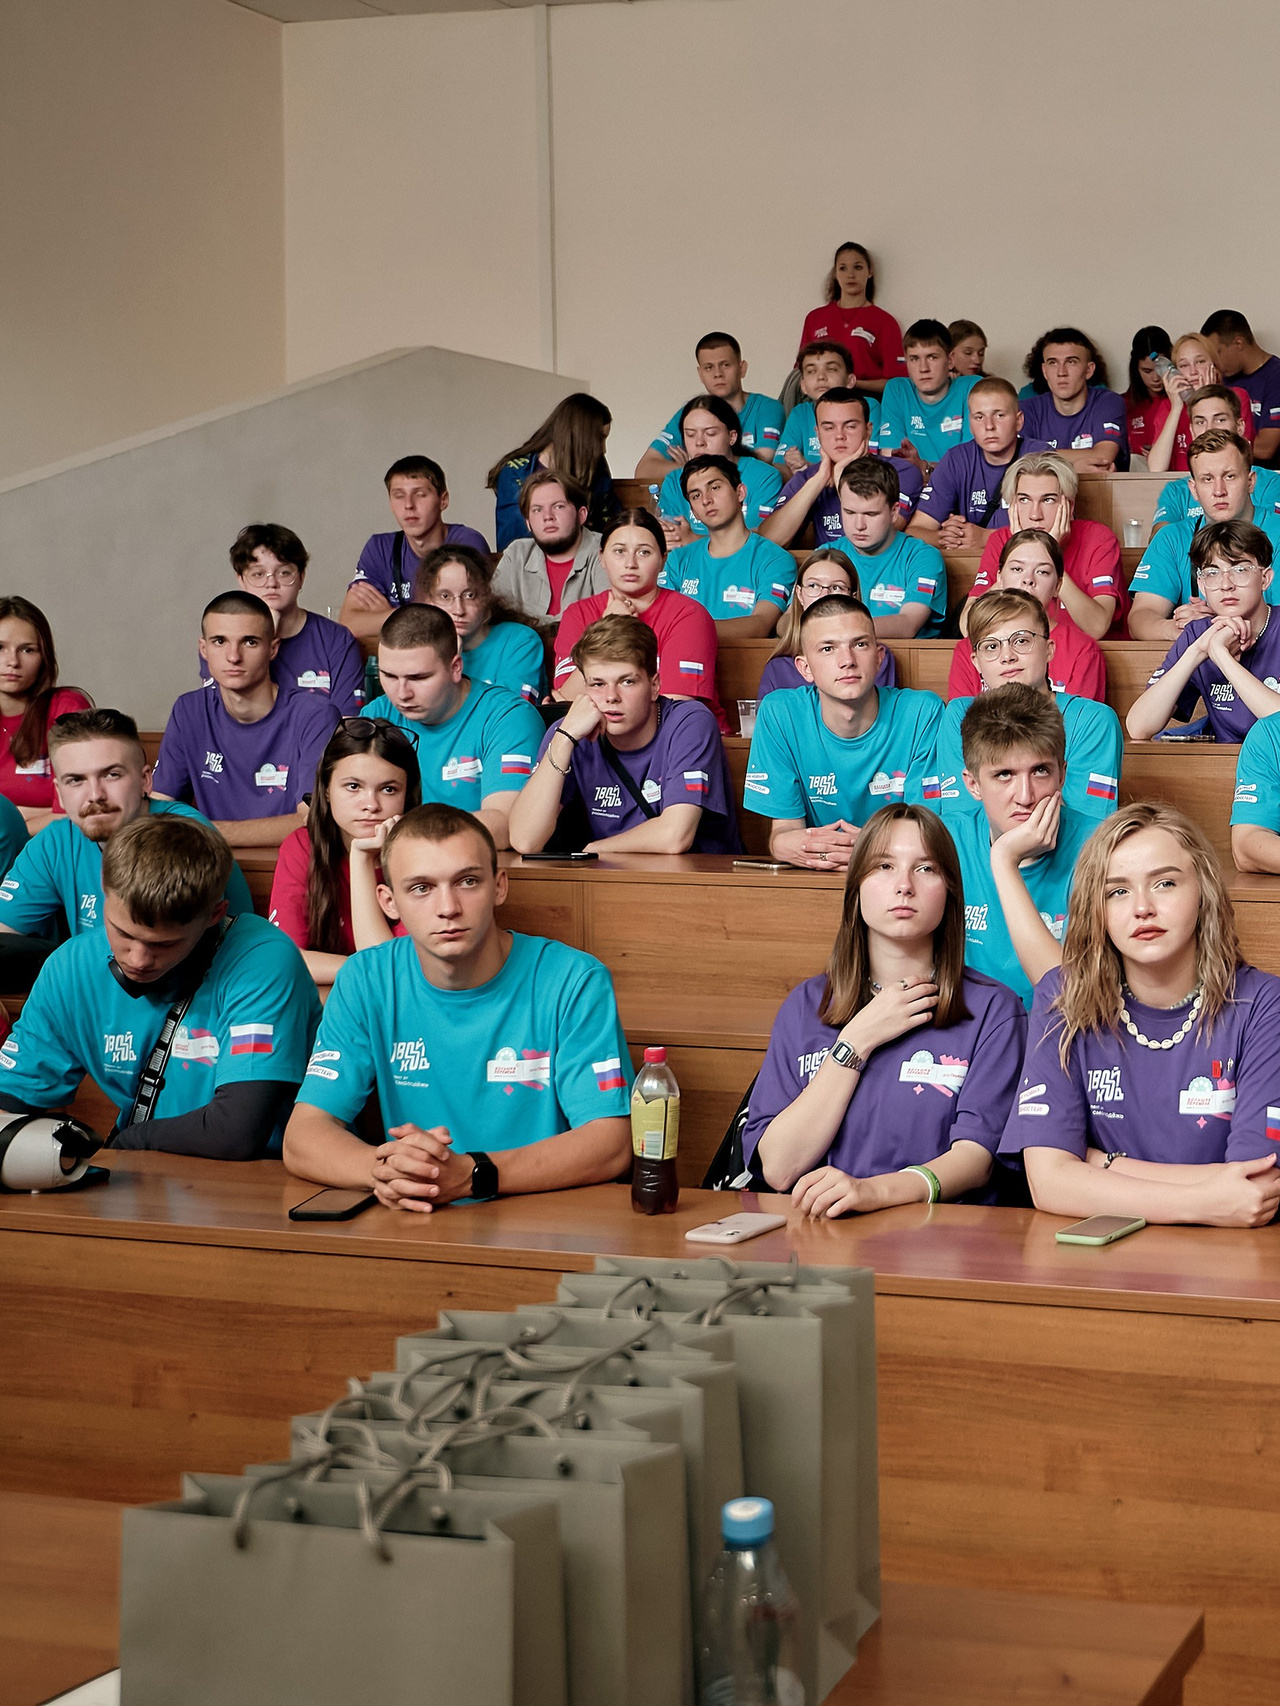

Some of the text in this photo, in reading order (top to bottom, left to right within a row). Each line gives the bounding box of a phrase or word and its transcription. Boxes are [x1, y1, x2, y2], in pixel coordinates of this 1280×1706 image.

[964, 904, 989, 920] ВОЙ
[390, 1037, 426, 1063] ТВОЙ
[399, 1055, 431, 1072] ХОД
[1087, 1066, 1121, 1093] ТВОЙ
[1096, 1086, 1124, 1103] ХОД
